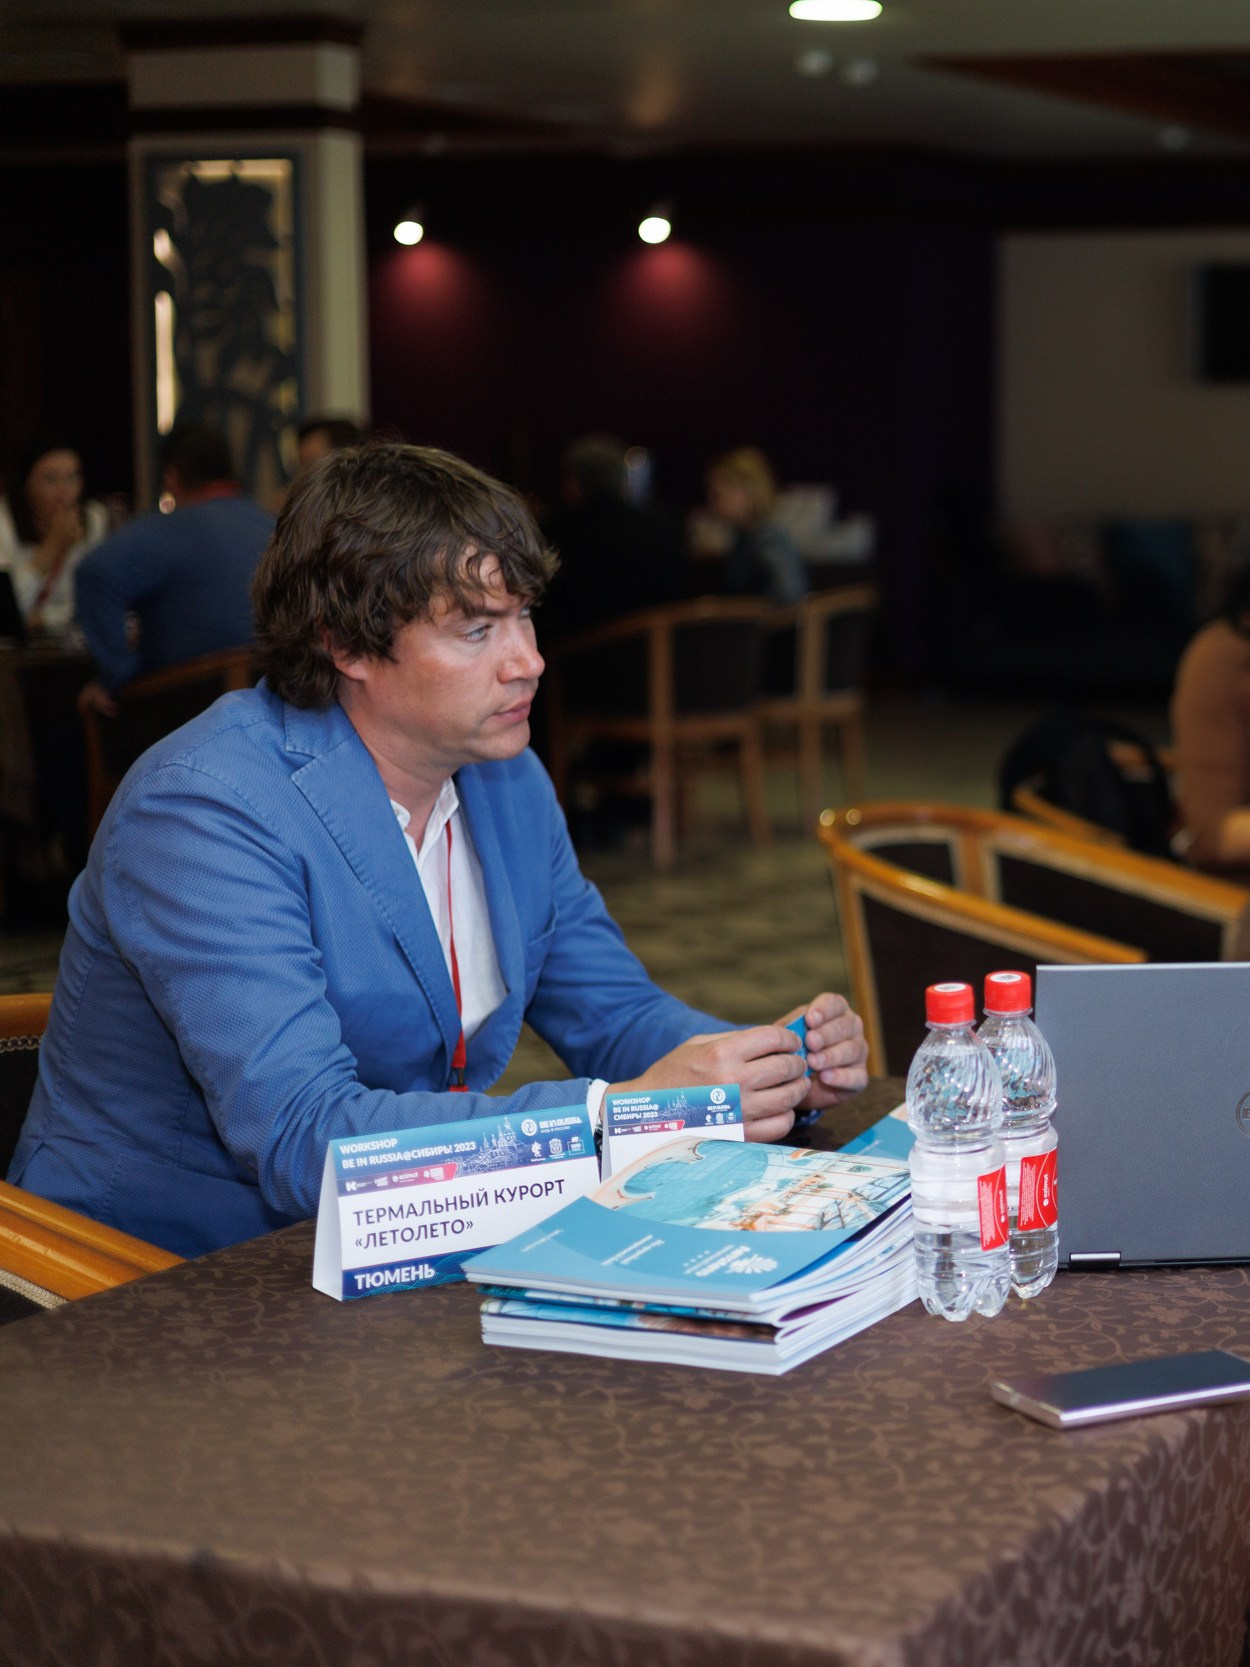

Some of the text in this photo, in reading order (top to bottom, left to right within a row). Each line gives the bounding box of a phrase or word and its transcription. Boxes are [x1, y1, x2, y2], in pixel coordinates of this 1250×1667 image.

[612, 1096, 651, 1106] WORKSHOP
[612, 1106, 622, 1114] BE
[622, 1105, 630, 1113] IN
[340, 1138, 398, 1155] WORKSHOP
[341, 1158, 356, 1169] BE
[357, 1156, 368, 1167] IN
[454, 1141, 477, 1153] 2023
[353, 1179, 565, 1227] ТЕРМАЛЬНЫЙ КУРОРТ
[355, 1219, 474, 1250] «ЛЕТОЛЕТО»
[354, 1263, 436, 1290] ТЮМЕНЬ
